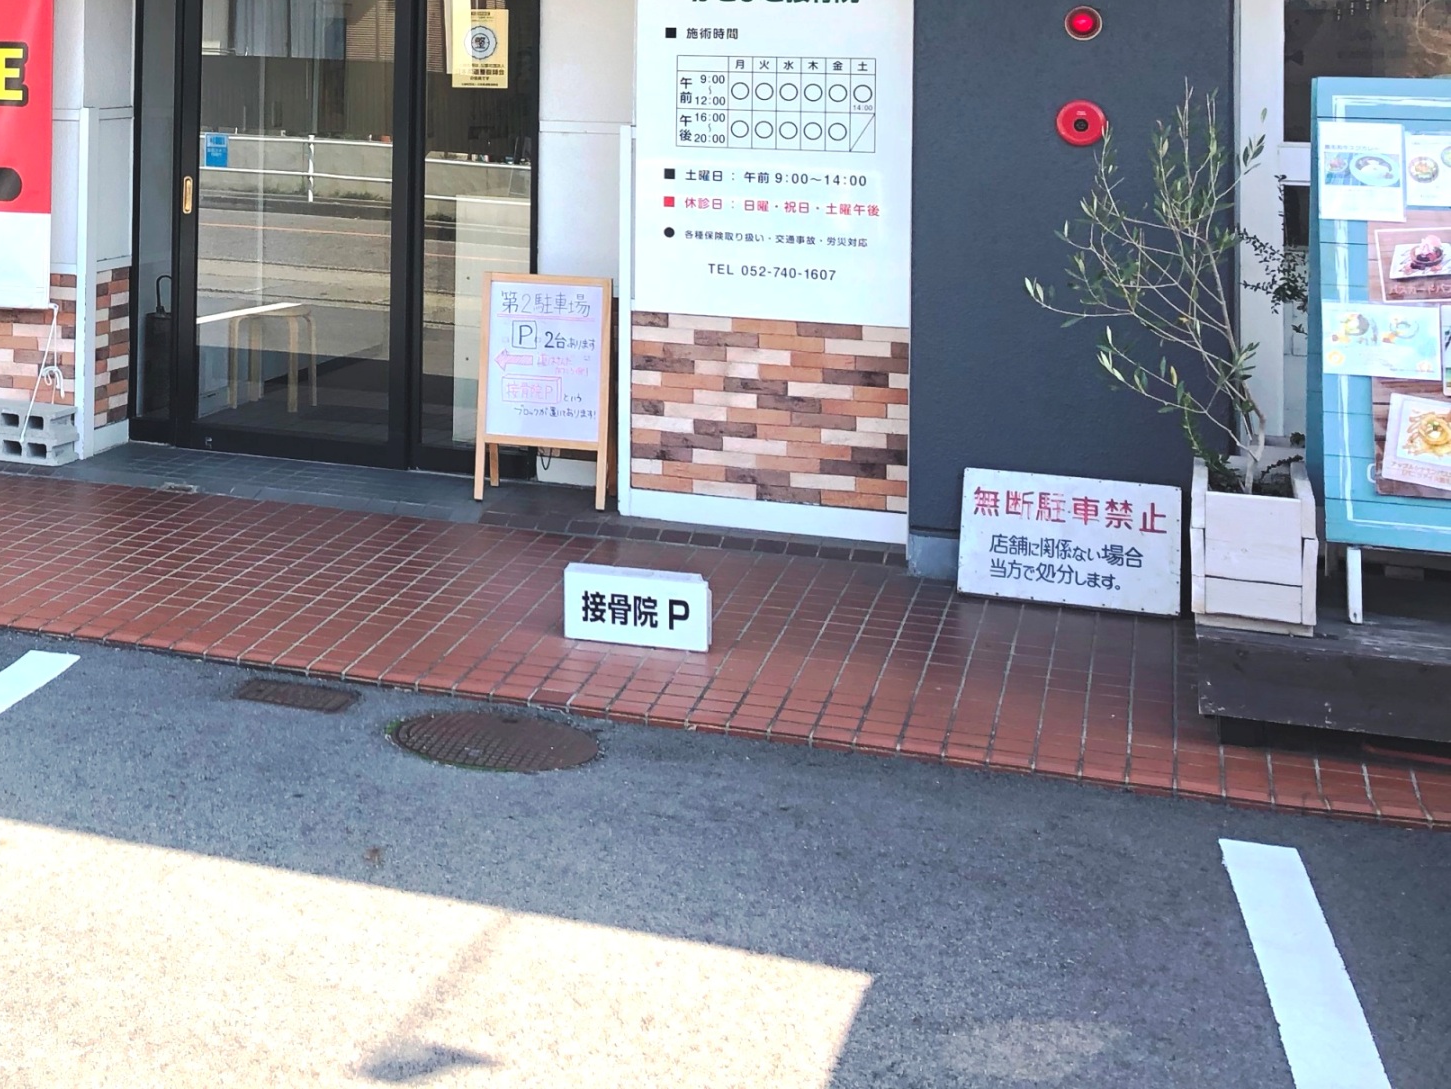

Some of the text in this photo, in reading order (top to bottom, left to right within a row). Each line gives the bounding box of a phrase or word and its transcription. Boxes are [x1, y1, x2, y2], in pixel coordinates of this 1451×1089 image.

[686, 27, 739, 40] 施術時間
[735, 60, 745, 70] 月
[759, 60, 770, 70] 火
[783, 61, 794, 70] 水
[807, 61, 818, 70] 木
[832, 61, 843, 71] 金
[857, 62, 868, 71] 土
[700, 74, 725, 85] 9:00
[680, 77, 692, 104] 午前
[695, 96, 726, 106] 12:00
[695, 113, 725, 123] 16:00
[679, 115, 692, 142] 午後
[694, 133, 725, 144] 20:00
[708, 264, 836, 281] TEL 052-740-1607
[501, 291, 591, 318] 第2駐車場
[974, 486, 1168, 534] 無断駐車禁止
[989, 534, 1144, 568] 店舗に関係ない場合
[989, 558, 1121, 591] 当方で処分します。
[581, 590, 690, 630] 接骨院 P
